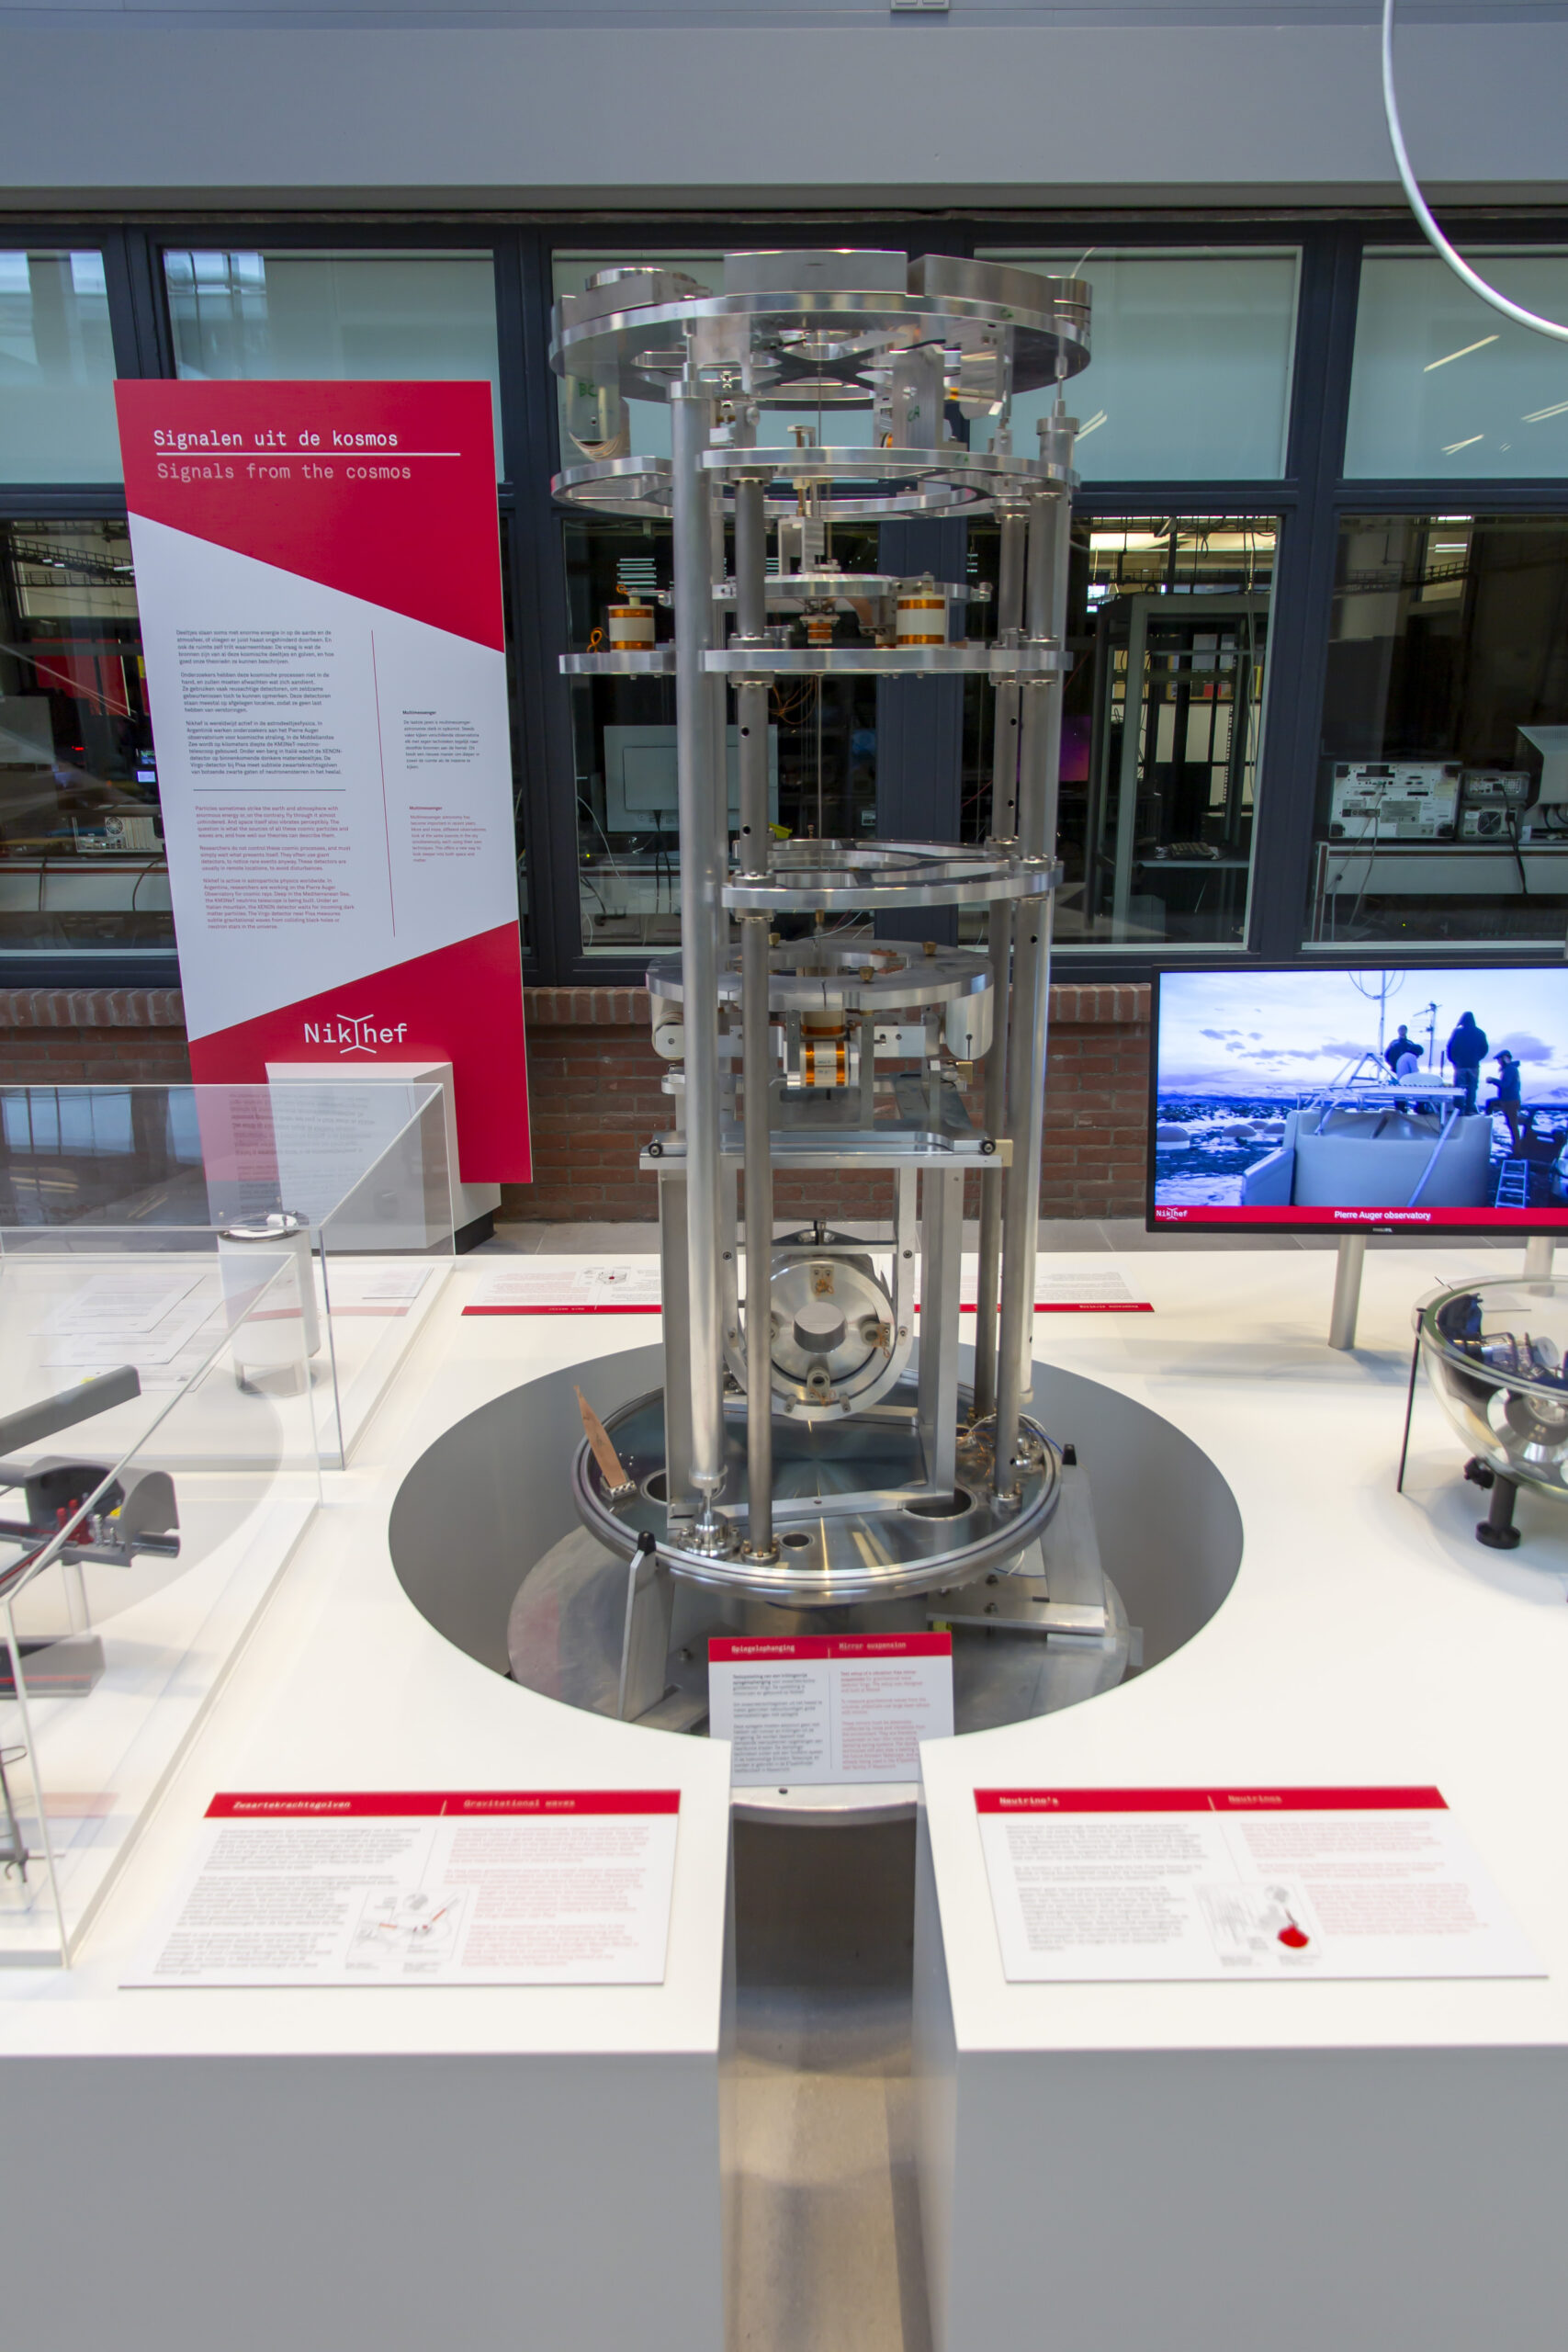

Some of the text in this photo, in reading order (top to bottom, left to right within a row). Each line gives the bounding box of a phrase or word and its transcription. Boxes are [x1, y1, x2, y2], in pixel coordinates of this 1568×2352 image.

[579, 382, 598, 397] BC
[907, 405, 920, 422] CA
[154, 430, 397, 448] Signalen uit de kosmos
[157, 463, 411, 482] Signals from the cosmos
[304, 1020, 407, 1046] Nikhef
[1156, 1209, 1188, 1218] Nikhef
[1359, 1211, 1382, 1221] Auger
[1384, 1211, 1431, 1221] observatory
[732, 1645, 795, 1654] Spiegelophanging
[233, 1800, 350, 1811] Zwaartekrachtsgolven
[464, 1800, 540, 1808] Gravitational
[999, 1796, 1060, 1806] Neutrino's
